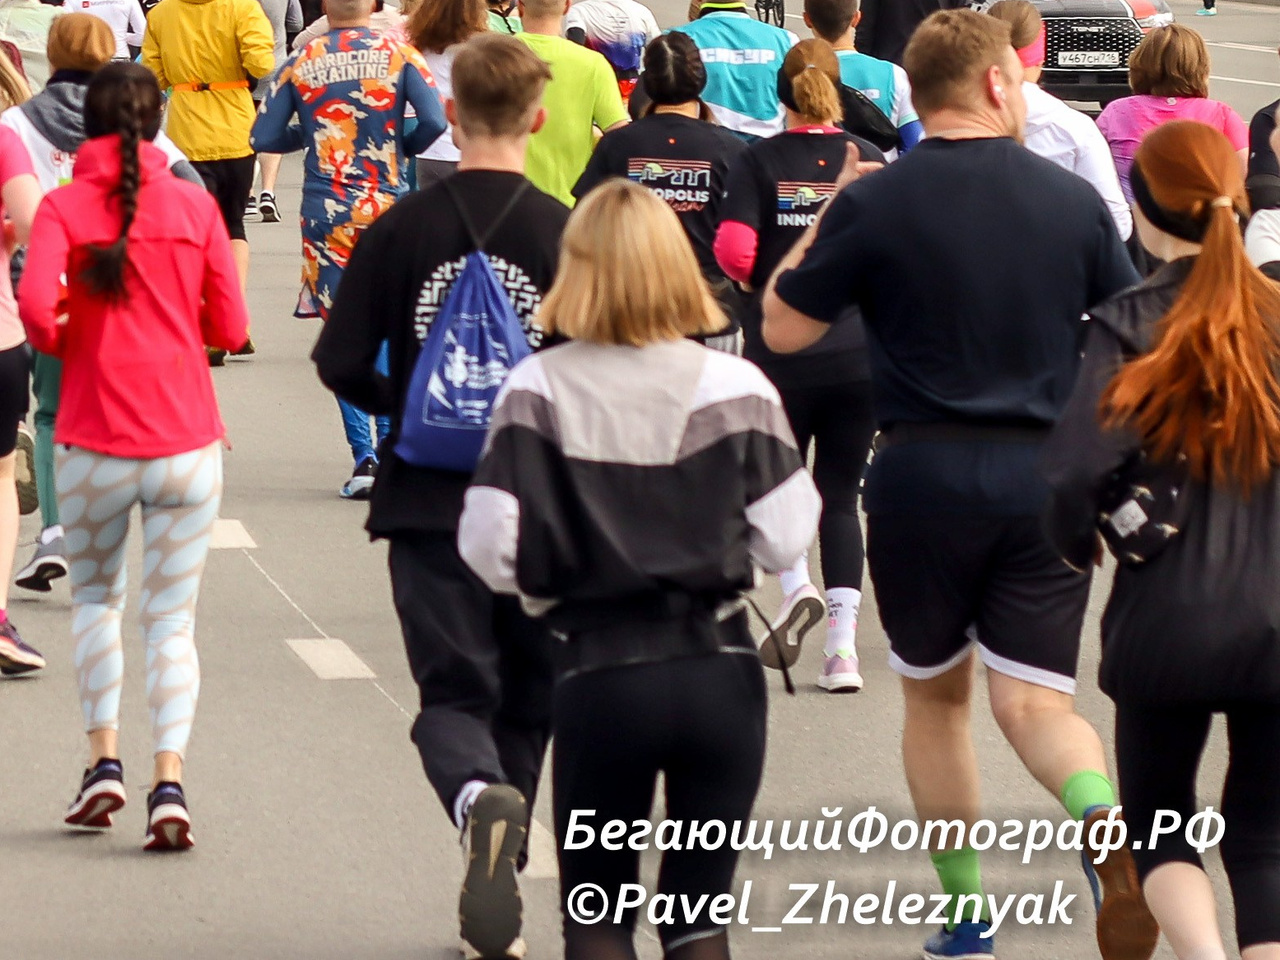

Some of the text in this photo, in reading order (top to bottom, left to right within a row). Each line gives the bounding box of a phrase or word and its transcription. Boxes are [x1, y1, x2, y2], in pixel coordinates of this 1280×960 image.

[301, 49, 391, 74] HARDCORE
[699, 48, 776, 65] СИБУР
[306, 63, 389, 90] TRAINING
